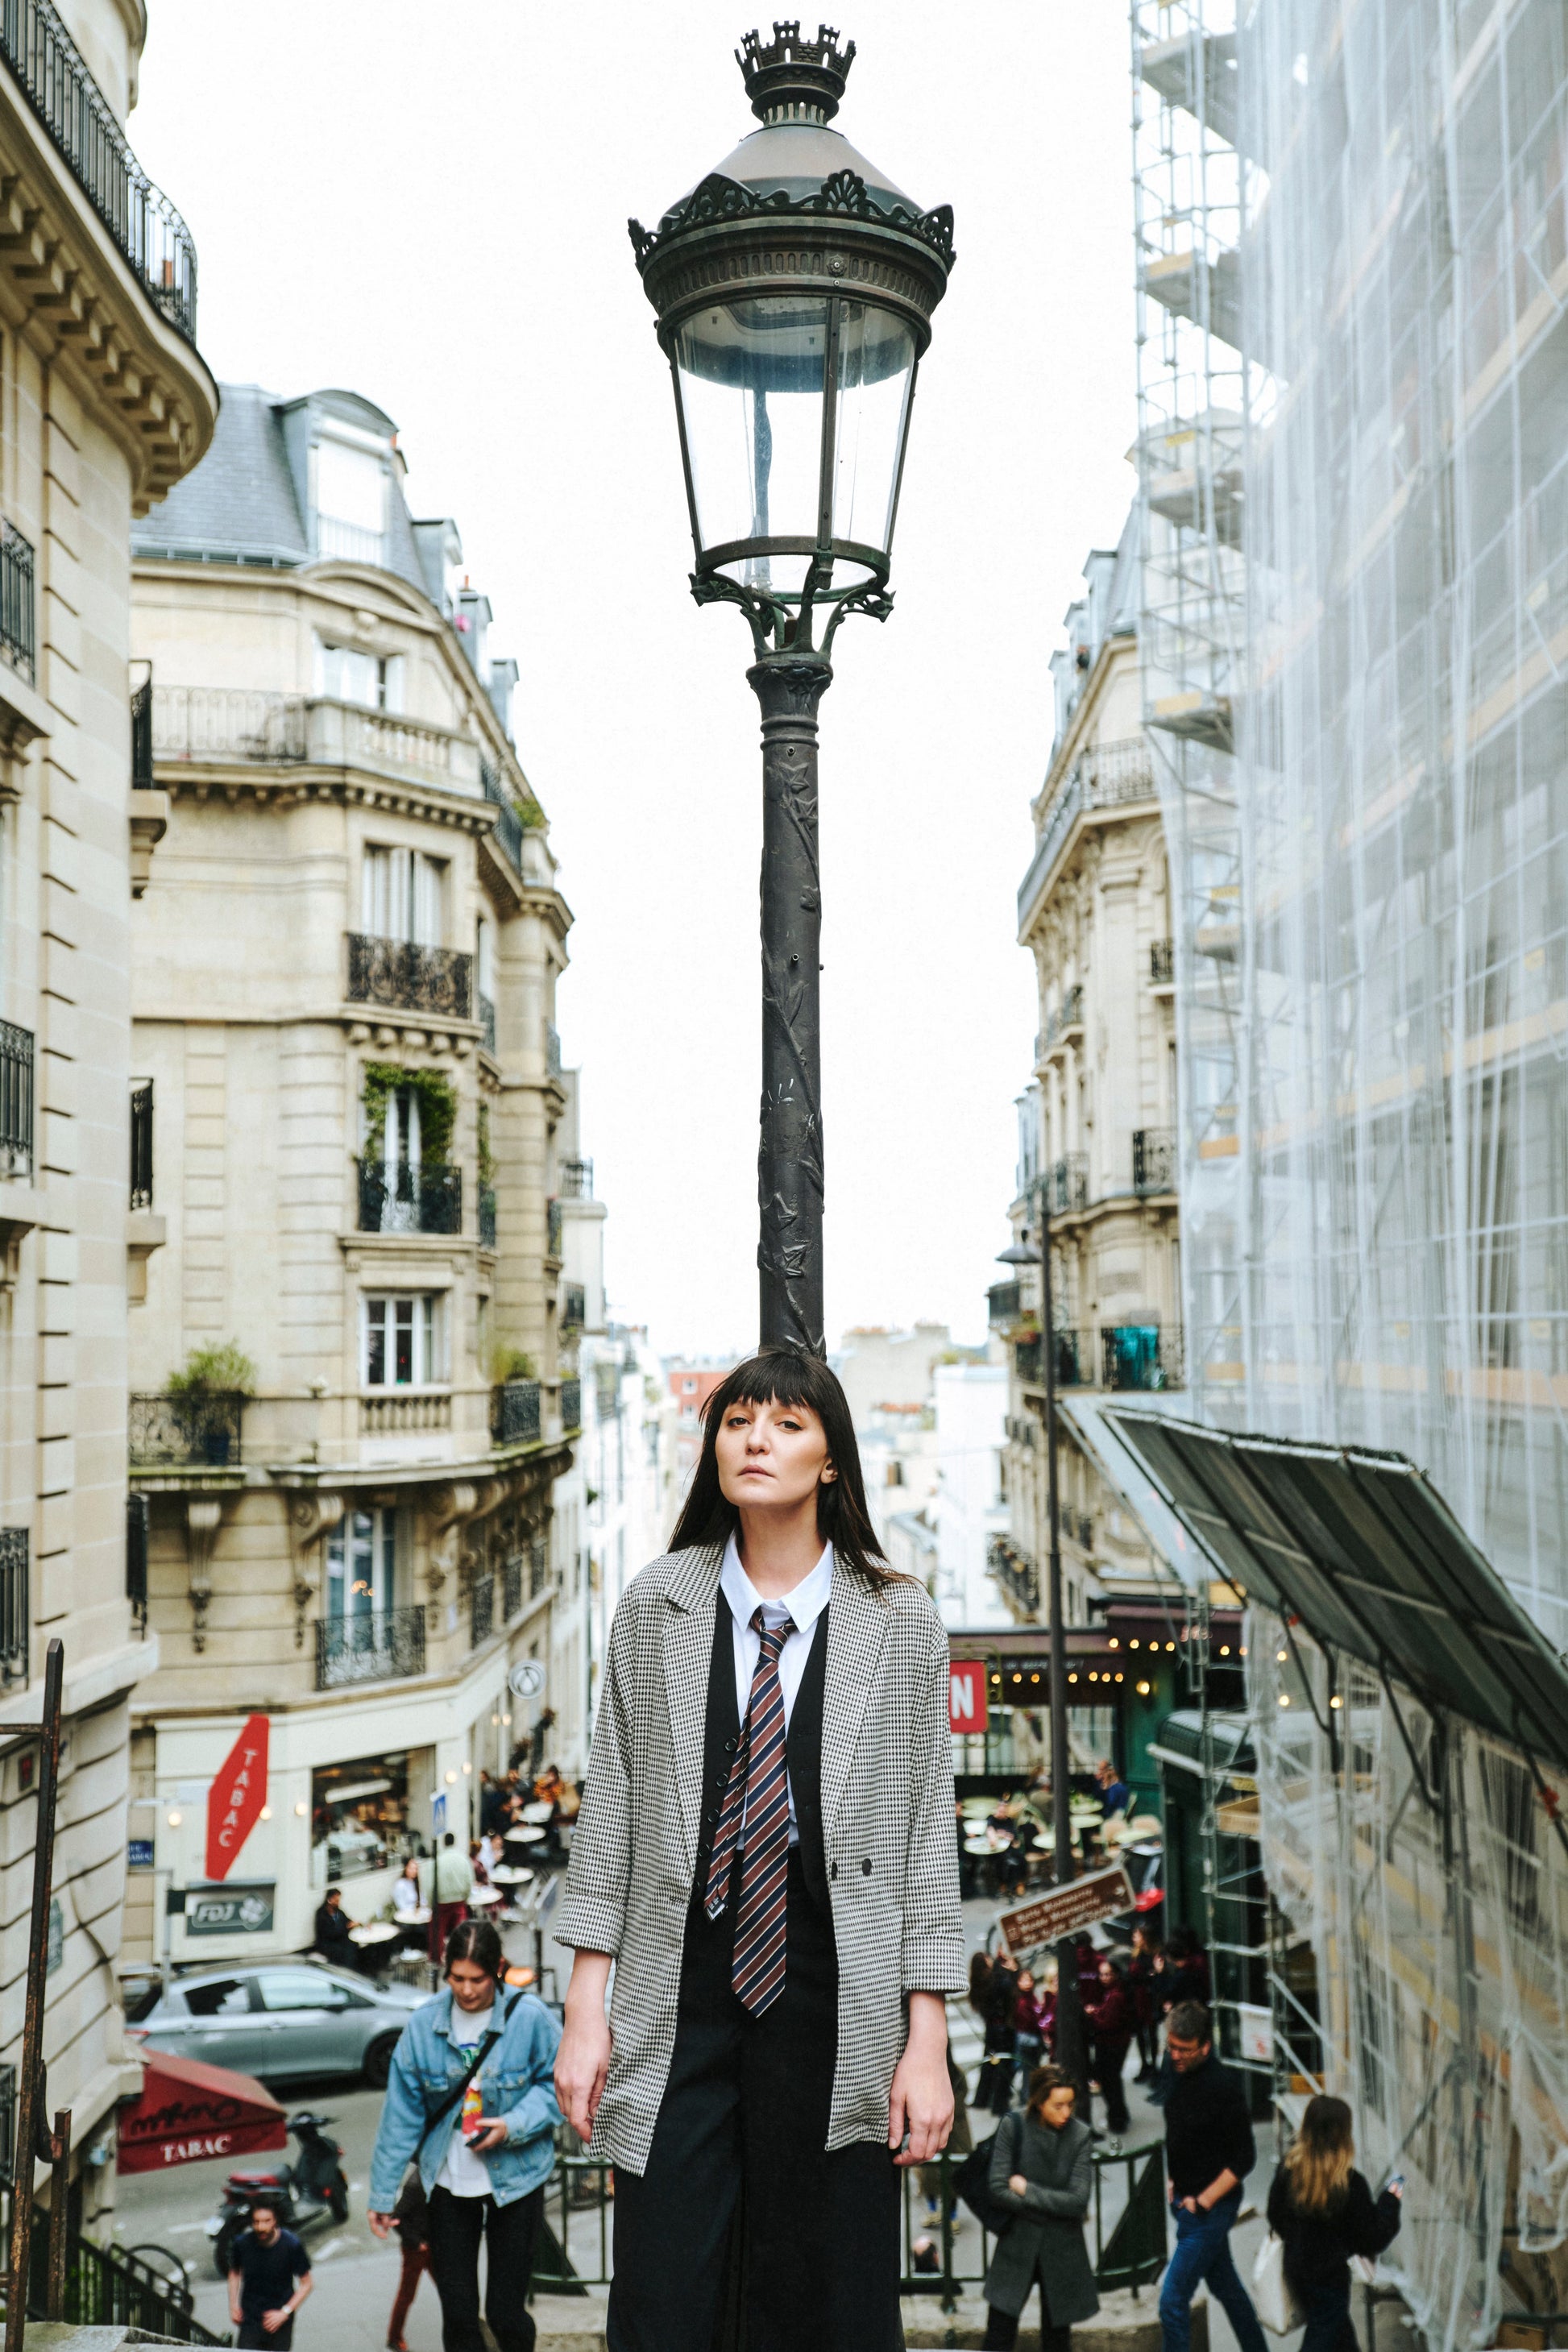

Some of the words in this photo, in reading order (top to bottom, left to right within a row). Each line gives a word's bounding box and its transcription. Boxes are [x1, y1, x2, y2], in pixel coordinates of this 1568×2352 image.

[218, 1748, 258, 1848] TABAC
[197, 1903, 235, 1923] FDJ
[163, 2134, 232, 2163] TABAC
